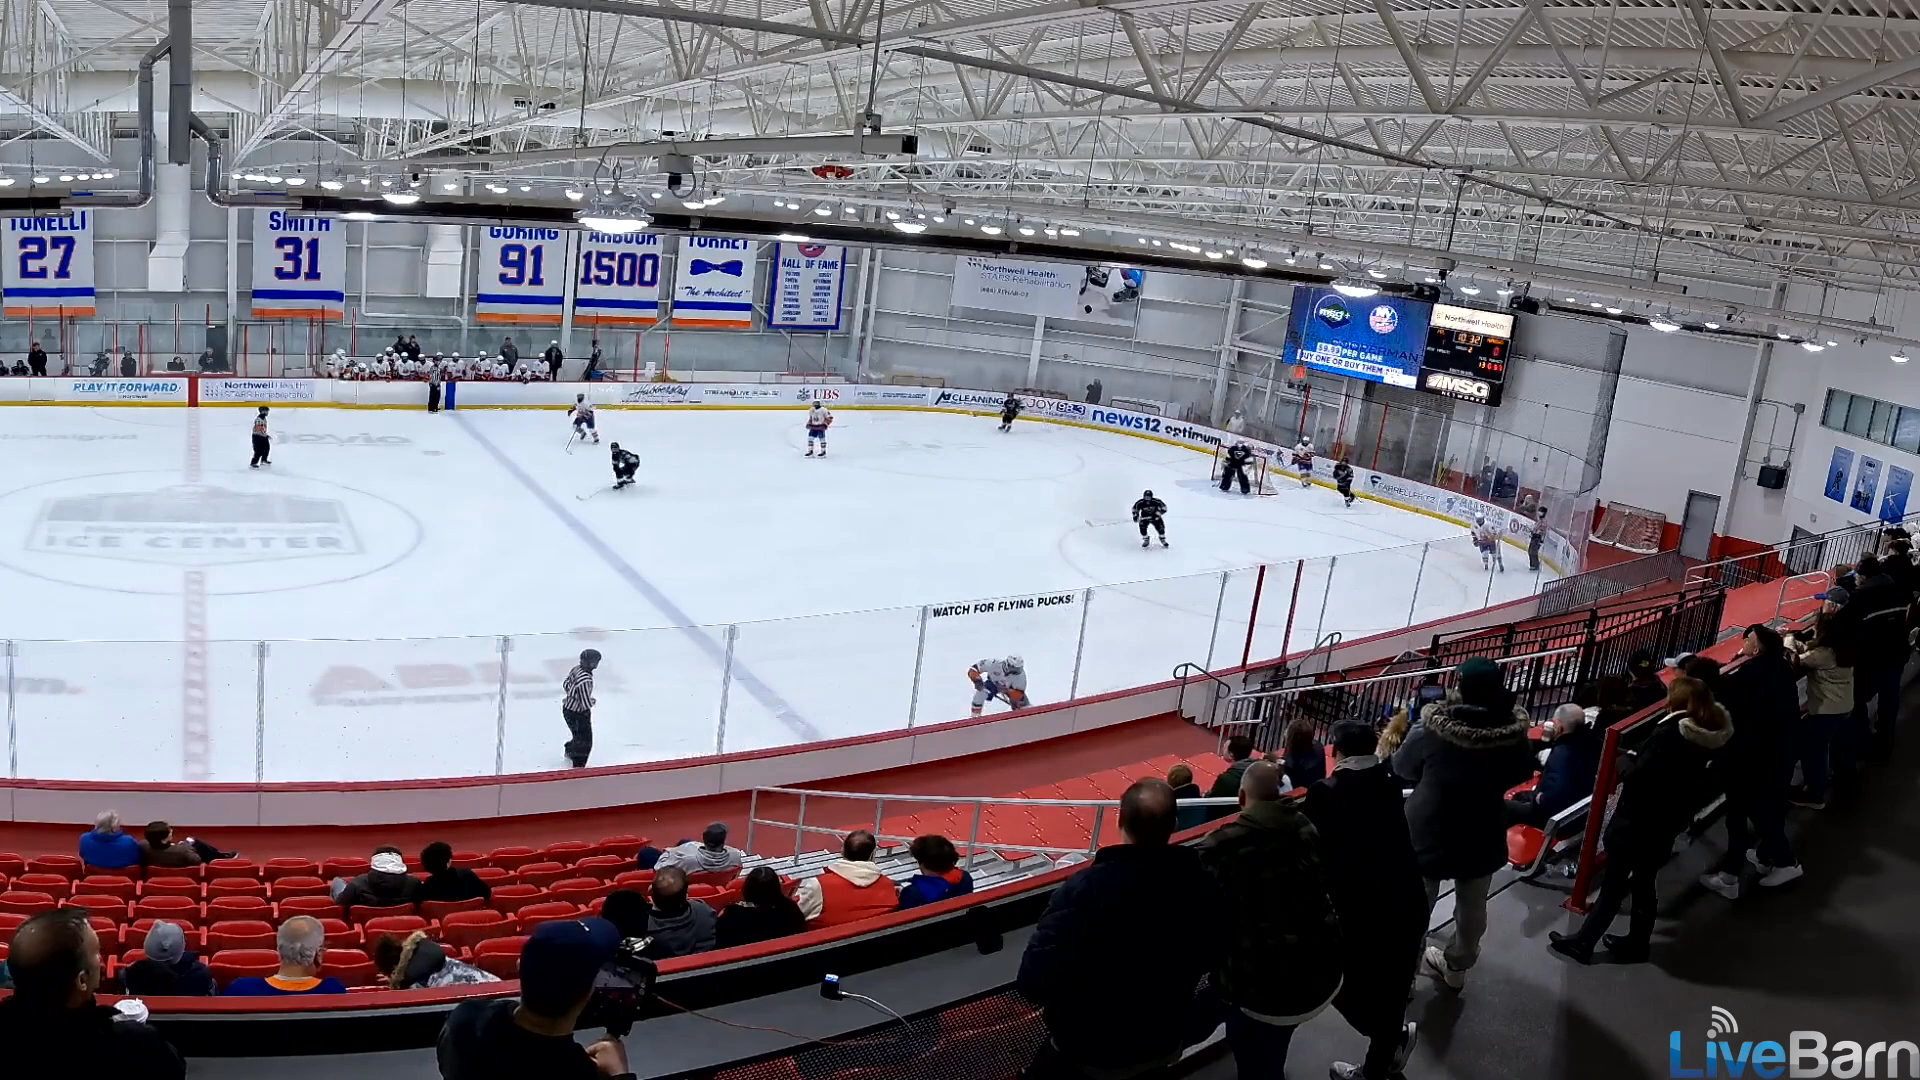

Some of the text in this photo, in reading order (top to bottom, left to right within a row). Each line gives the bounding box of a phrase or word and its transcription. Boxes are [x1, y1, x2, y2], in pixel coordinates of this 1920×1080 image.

[11, 211, 86, 231] TONELLI
[269, 211, 330, 231] SMITH
[19, 236, 76, 280] 27
[274, 236, 321, 281] 31
[499, 243, 544, 286] 91
[782, 258, 839, 269] HALL OF FAME
[580, 249, 659, 287] 1500
[982, 263, 1057, 279] Northwell Health
[980, 272, 1072, 289] STARS Rehabilitation
[1444, 313, 1505, 330] Northwell Health
[1315, 353, 1331, 363] ONE
[1332, 356, 1343, 366] OR
[1344, 358, 1360, 370] BUY
[1362, 362, 1383, 374] THEM
[1342, 348, 1358, 358] PER
[1359, 352, 1384, 362] GAME
[73, 383, 178, 392] PLAY IT FORWARD
[814, 389, 840, 400] UBS
[1441, 375, 1489, 398] MSG
[952, 393, 1003, 405] CLEANING
[1441, 391, 1486, 404] NETWORKS
[1164, 425, 1222, 446] optimum
[45, 535, 343, 549] ICE CENTER
[933, 595, 1074, 617] WATCH FOR FLYING PUCKS!
